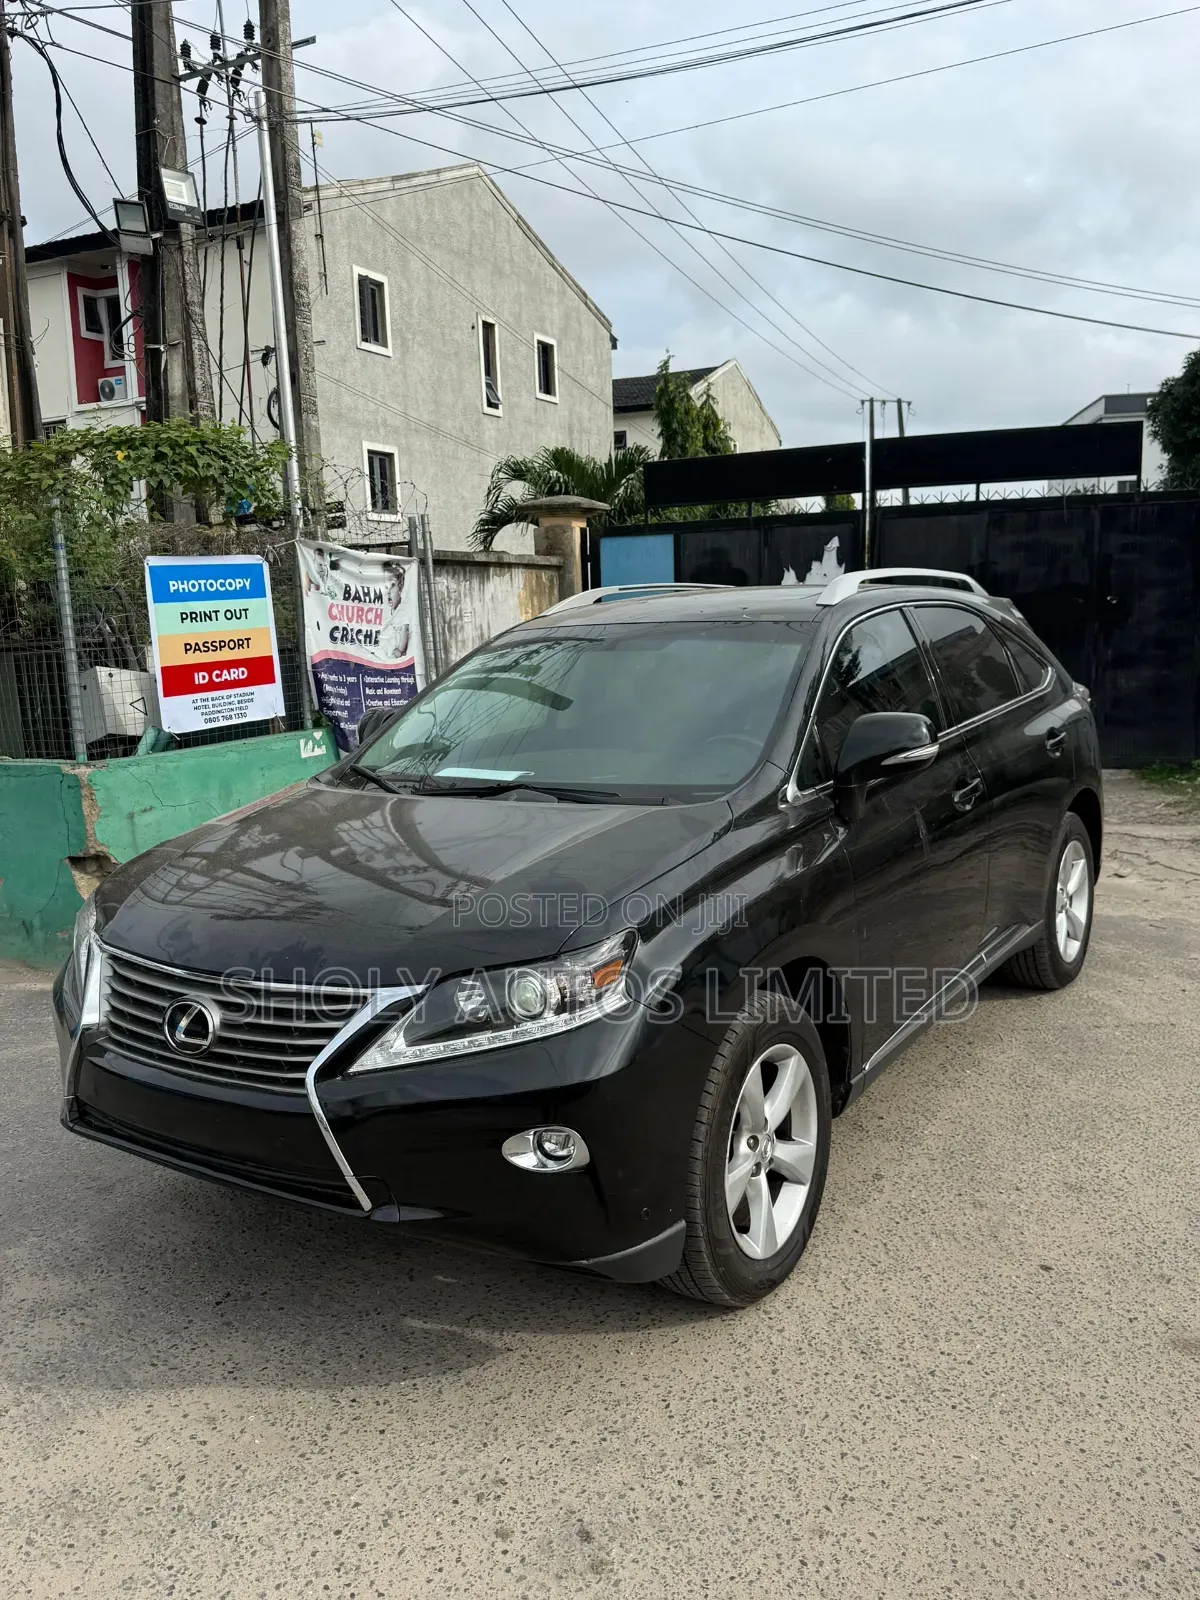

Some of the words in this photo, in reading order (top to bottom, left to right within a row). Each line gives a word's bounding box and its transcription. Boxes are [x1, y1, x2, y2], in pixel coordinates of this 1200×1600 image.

[169, 578, 251, 593] PHOTOCOPY
[342, 583, 383, 605] BAHM
[180, 609, 220, 623] PRINT
[224, 608, 249, 621] OUT
[328, 602, 384, 626] CHURCH
[184, 637, 251, 654] PASSPORT
[194, 672, 209, 684] ID
[212, 667, 248, 683] CARD
[385, 676, 401, 685] Learning
[237, 697, 254, 705] BESIDE
[201, 707, 235, 716] PADDINGTON
[203, 716, 220, 724] 0805
